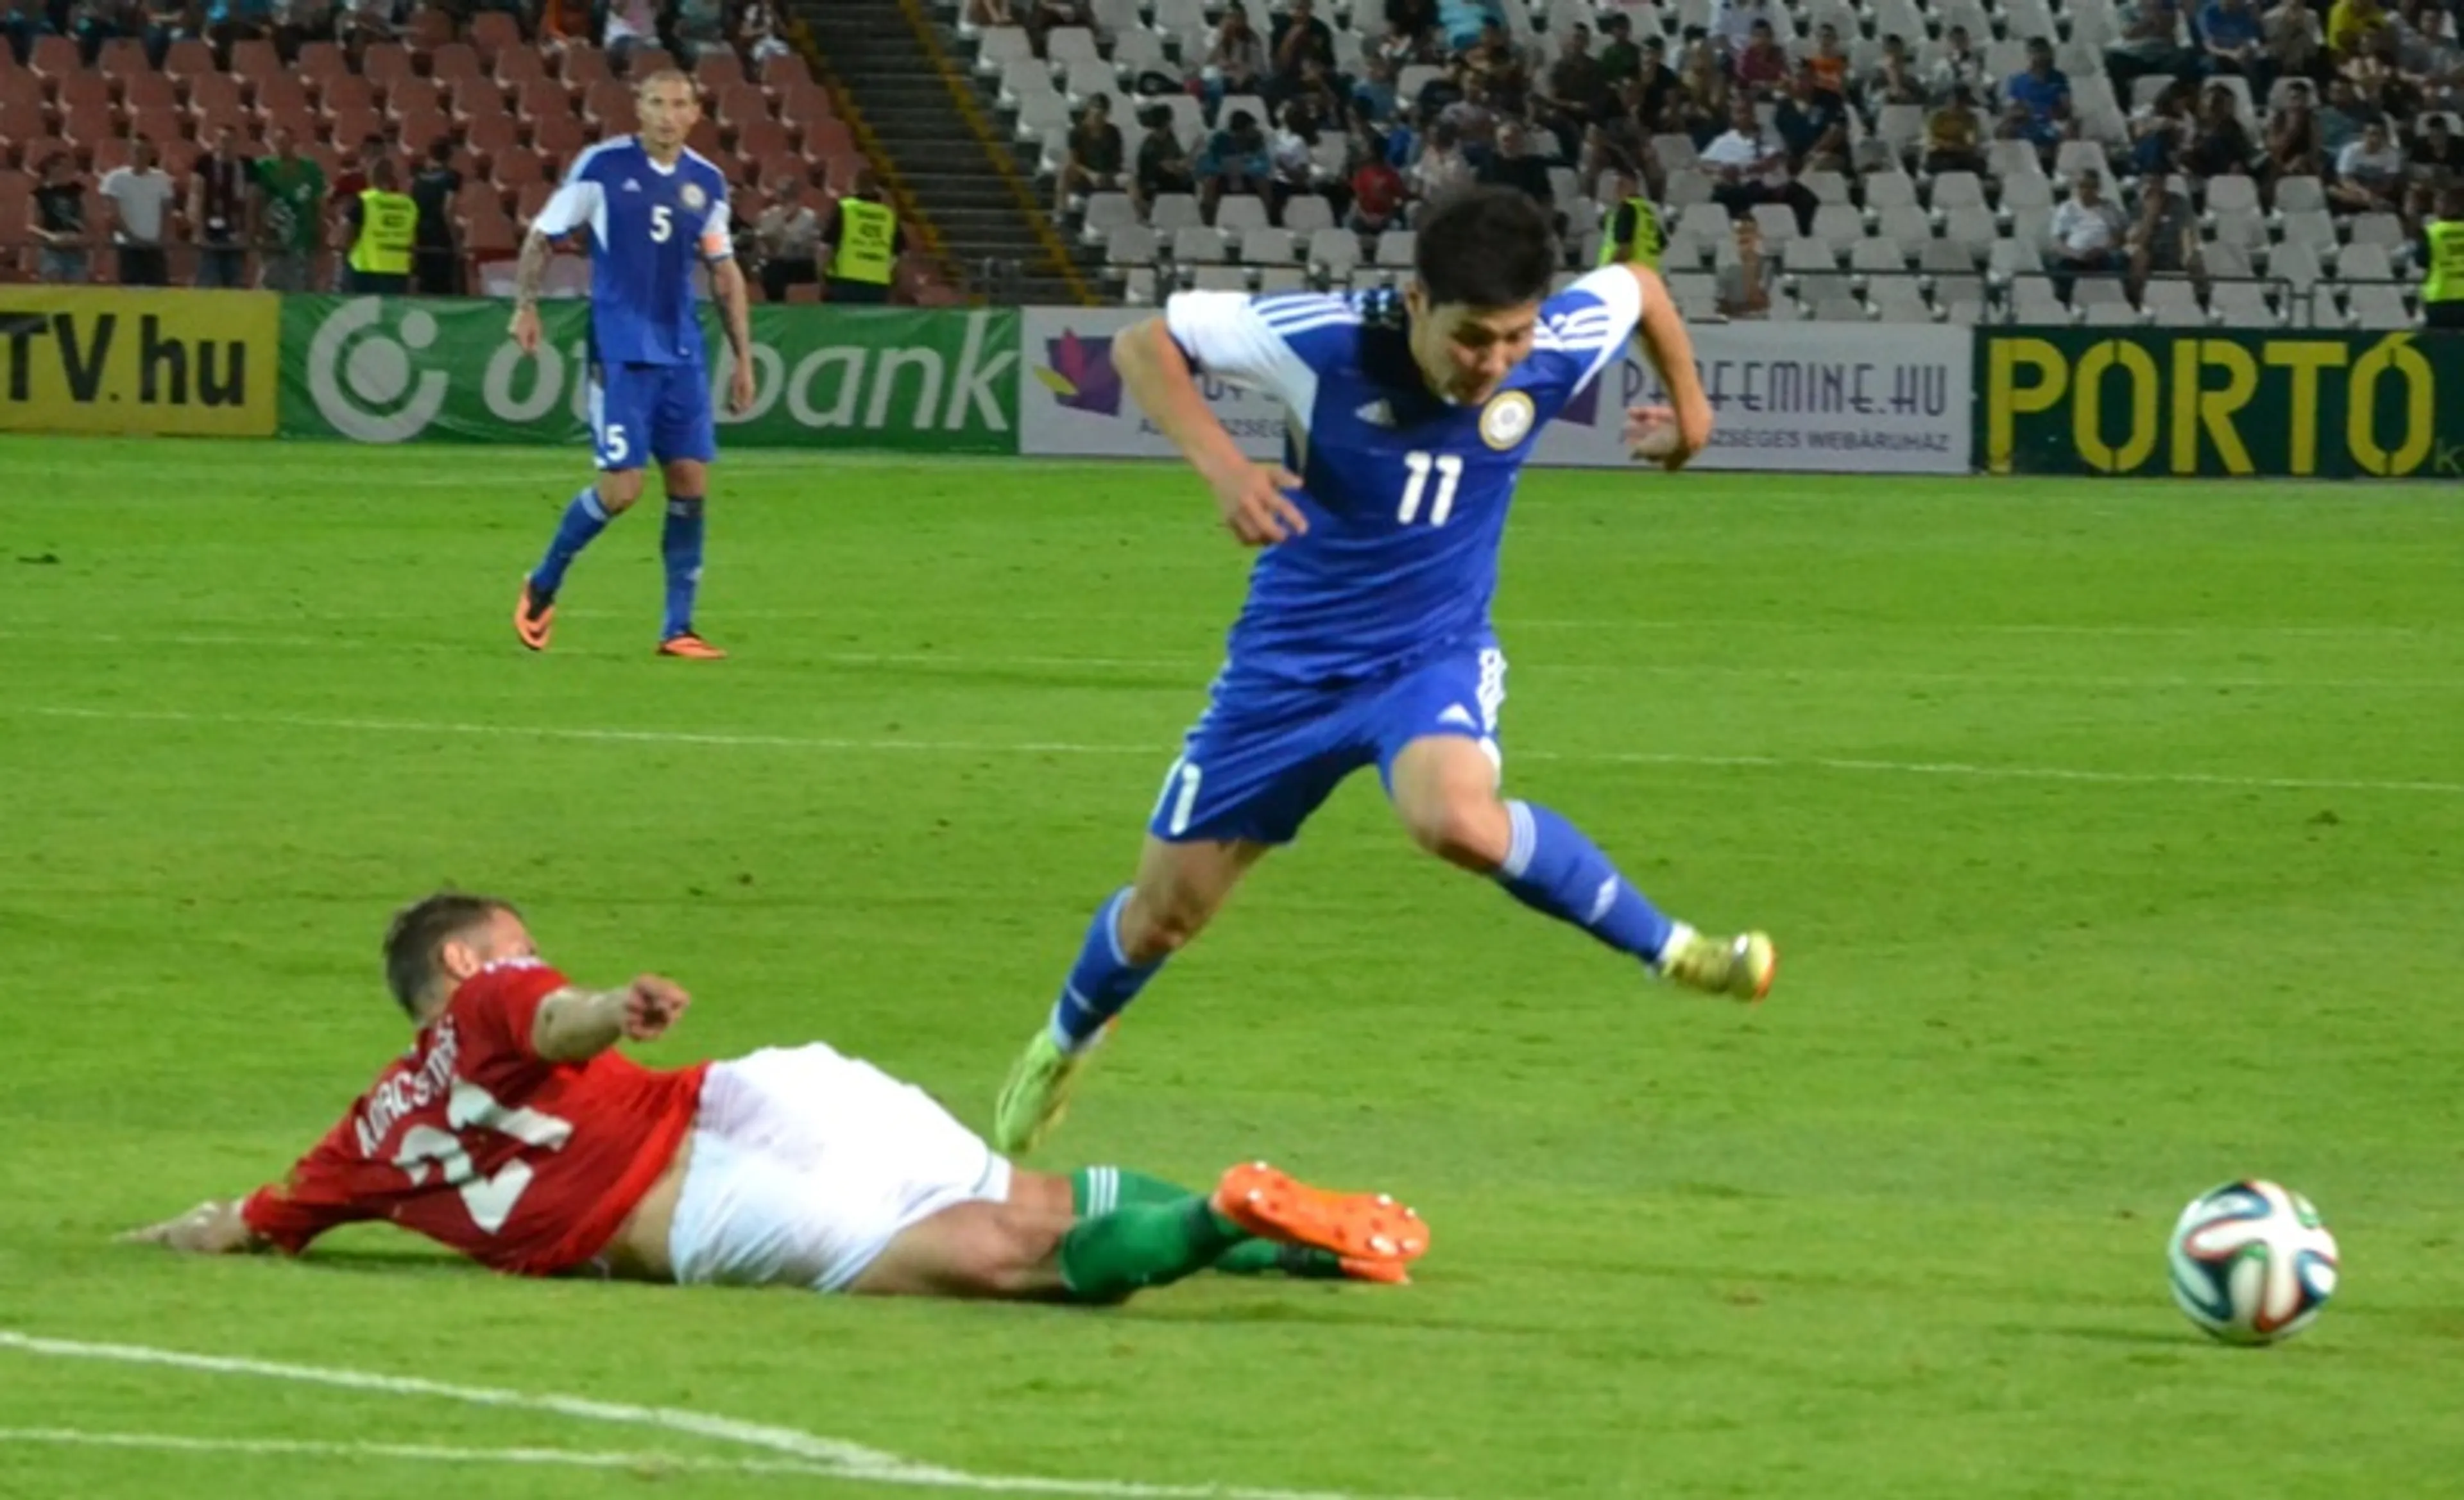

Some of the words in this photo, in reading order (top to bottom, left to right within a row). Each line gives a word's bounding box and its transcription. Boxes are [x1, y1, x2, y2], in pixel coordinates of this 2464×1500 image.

[649, 202, 672, 243] 5
[0, 311, 246, 407] TV.hu
[604, 423, 629, 462] 5
[1989, 332, 2434, 476] PORTÓ
[1397, 450, 1464, 527] 11
